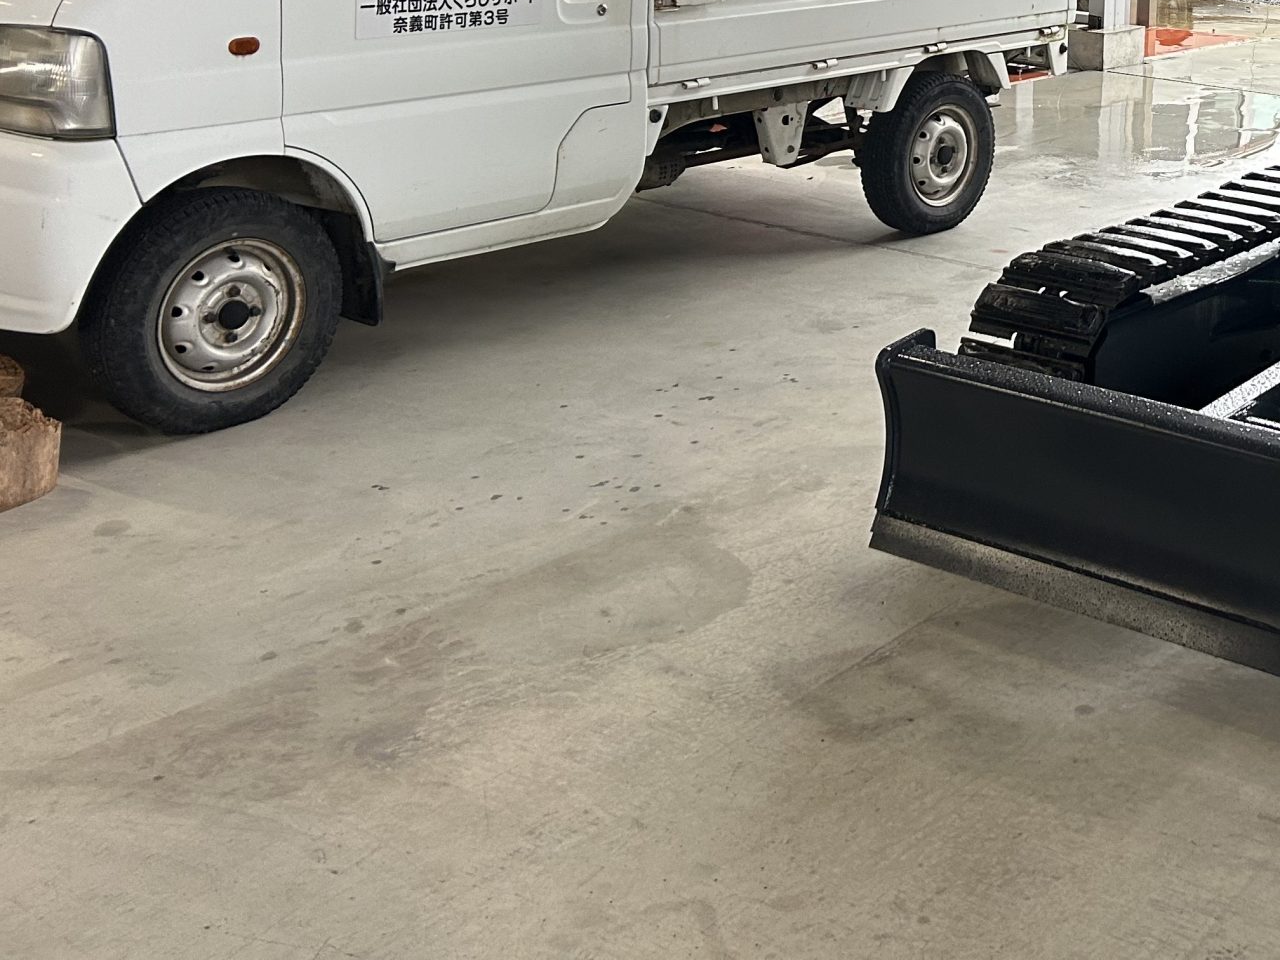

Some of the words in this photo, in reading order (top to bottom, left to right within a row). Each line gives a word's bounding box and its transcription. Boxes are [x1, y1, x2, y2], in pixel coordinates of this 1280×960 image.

[393, 8, 510, 34] 奈義町許可第3号
